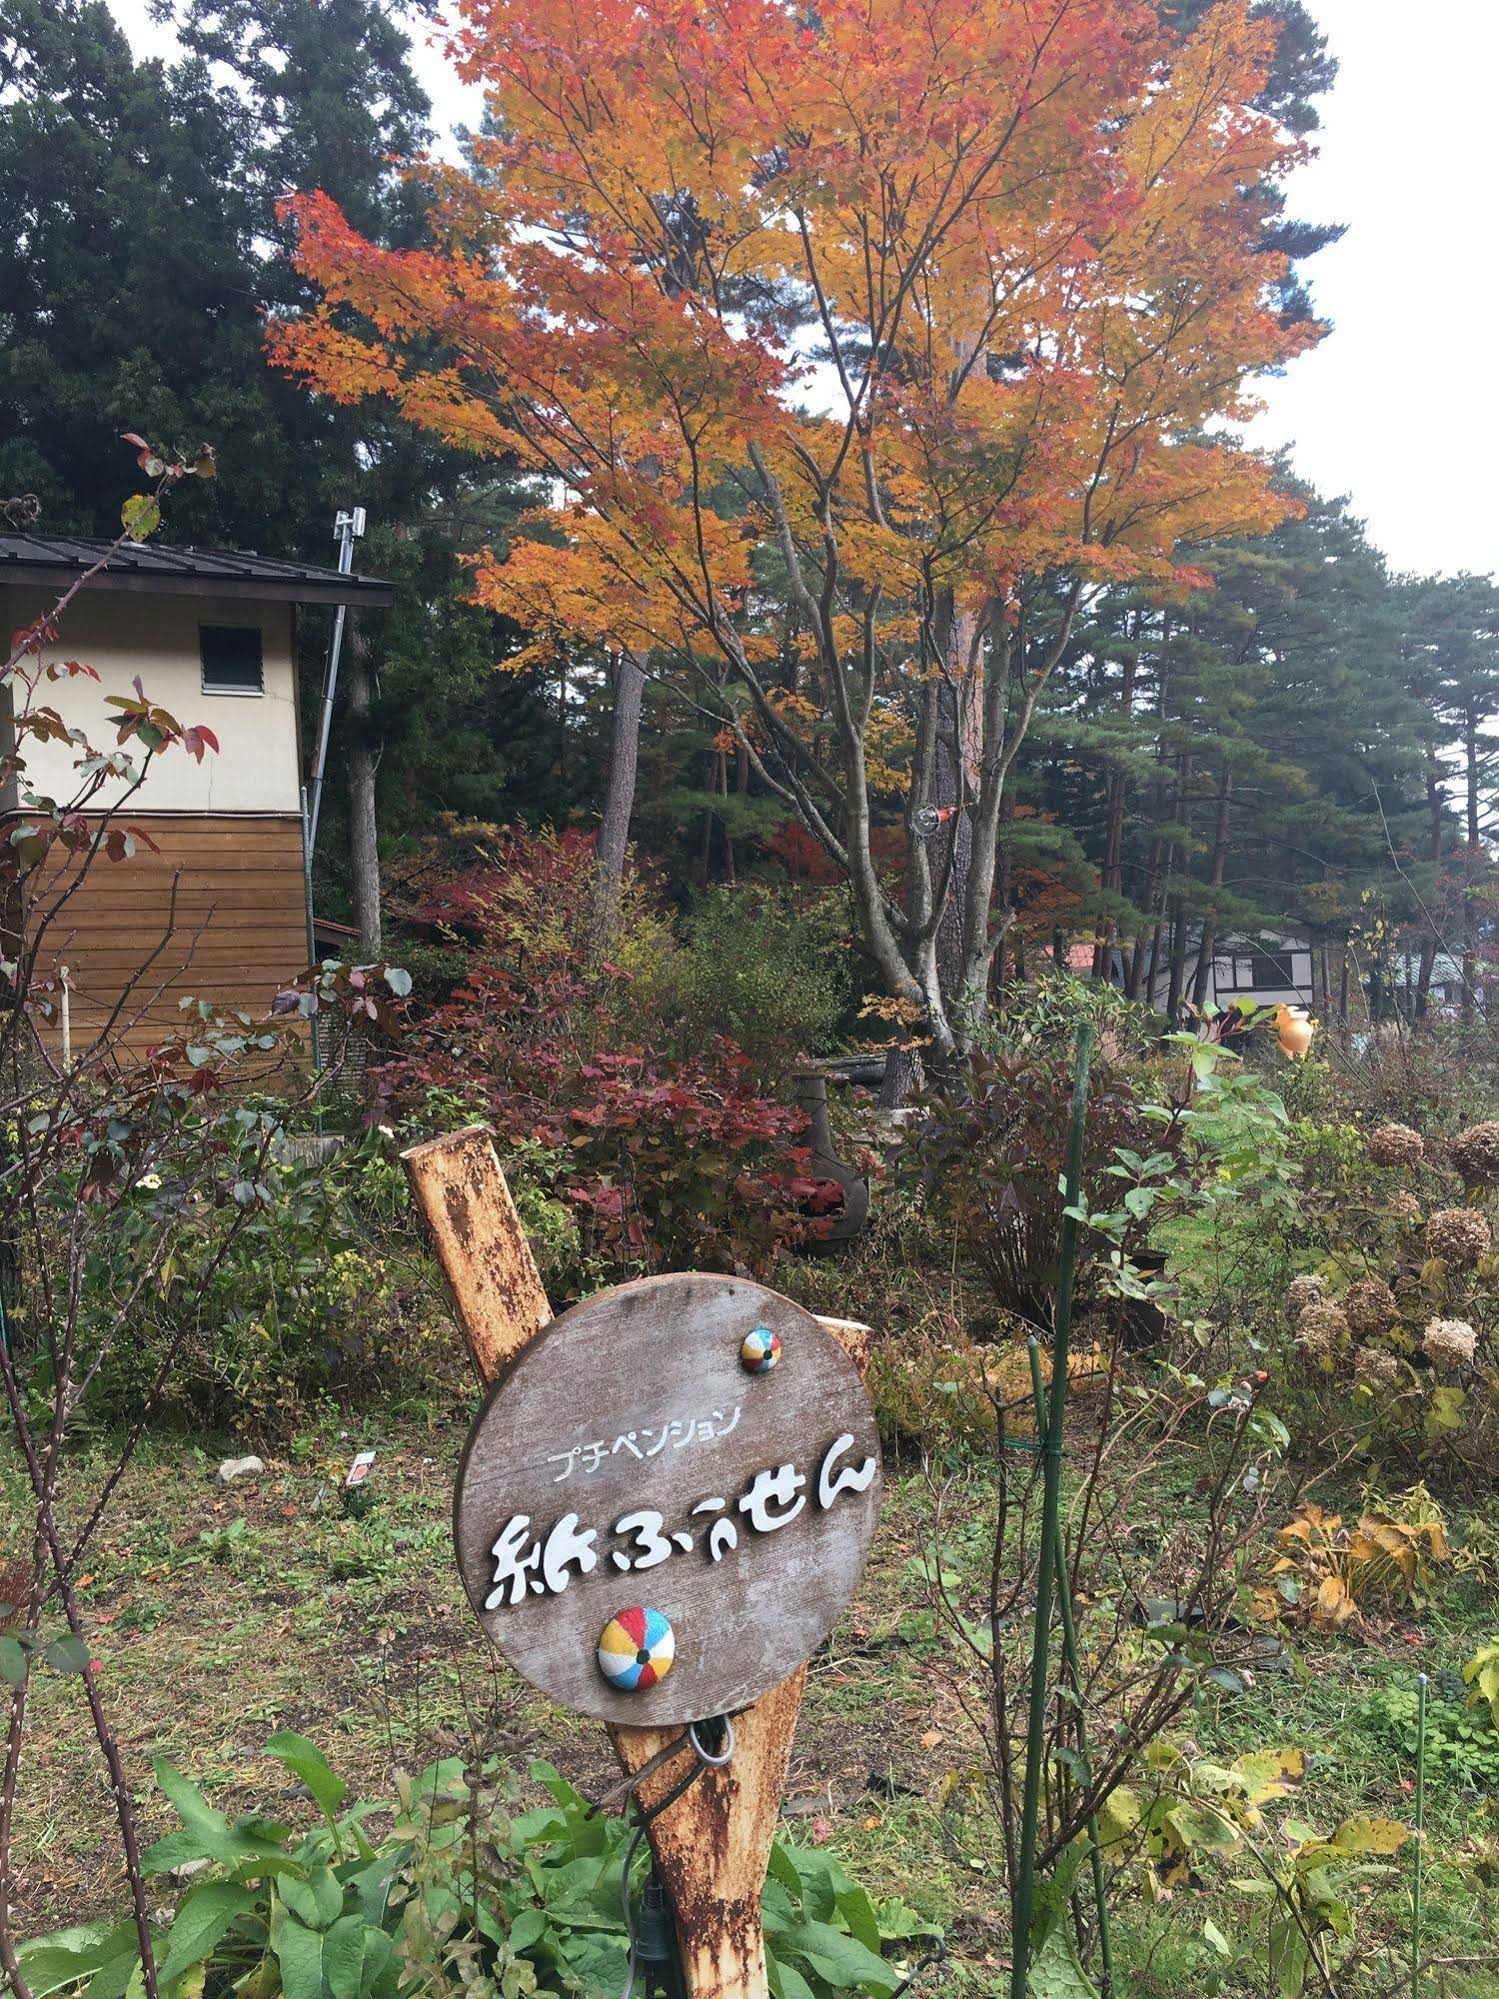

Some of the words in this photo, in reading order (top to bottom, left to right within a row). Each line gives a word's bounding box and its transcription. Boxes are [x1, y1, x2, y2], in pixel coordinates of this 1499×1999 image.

[547, 1405, 742, 1482] プチペンション
[484, 1433, 877, 1610] 紙ふうせん
